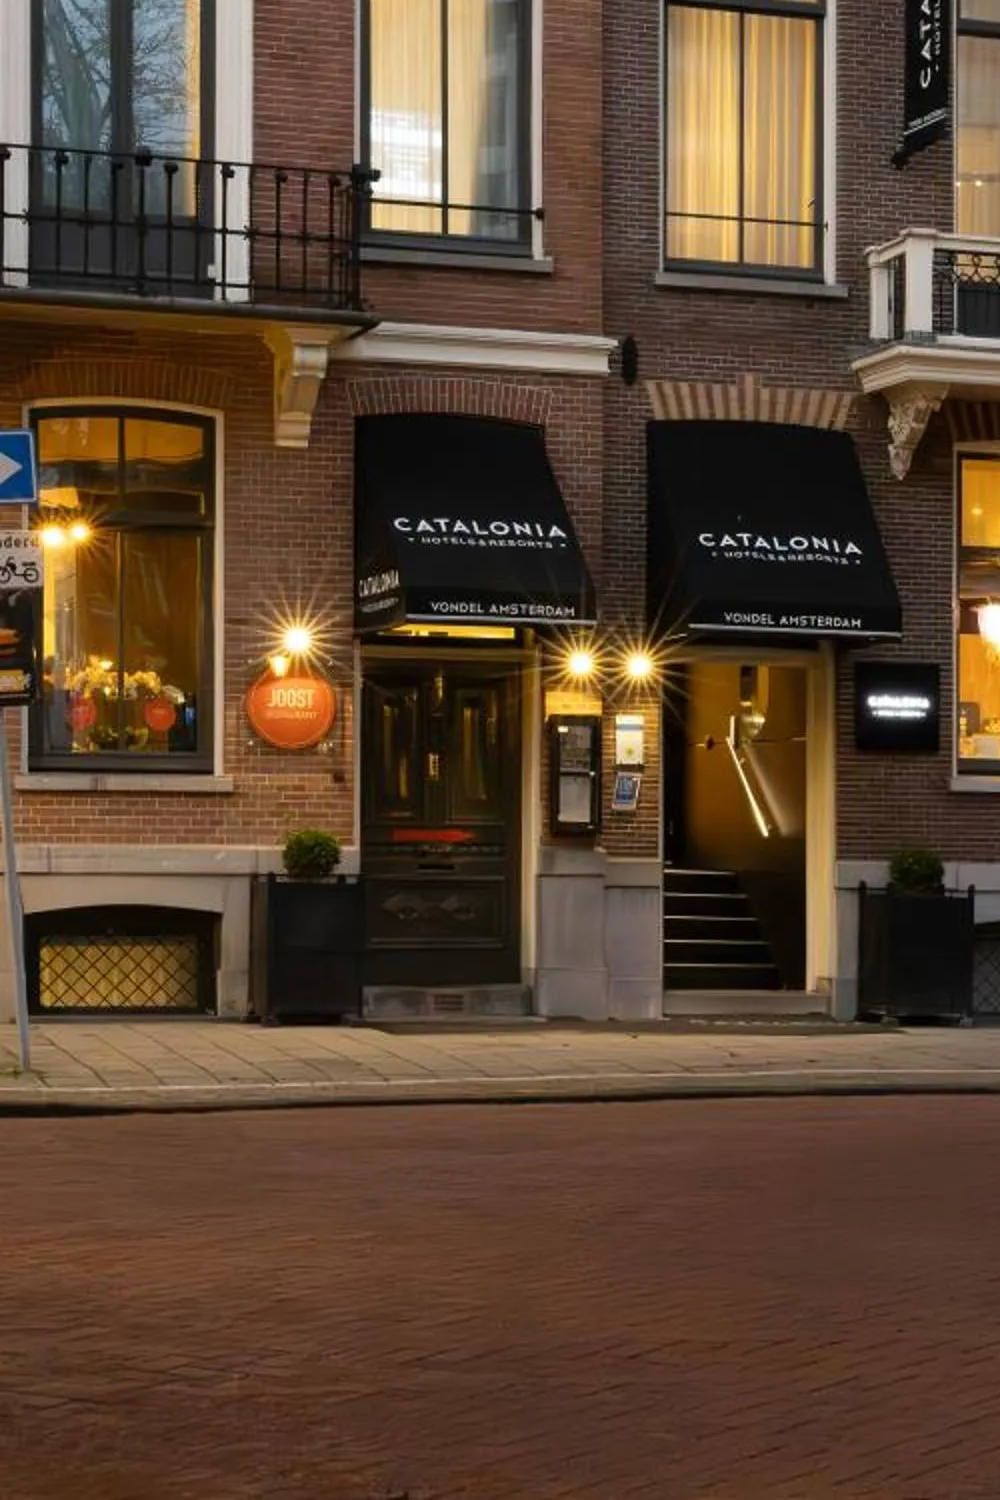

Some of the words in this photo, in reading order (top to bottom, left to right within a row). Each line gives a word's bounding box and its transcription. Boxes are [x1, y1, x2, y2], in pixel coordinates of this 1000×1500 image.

[393, 517, 567, 538] CATALONIA
[699, 533, 863, 555] CATALONIA
[431, 601, 485, 614] VONDEL
[489, 603, 575, 617] AMSTERDAM
[723, 611, 775, 625] VONDEL
[779, 615, 861, 629] AMSTERDAM
[267, 688, 314, 708] JOOST
